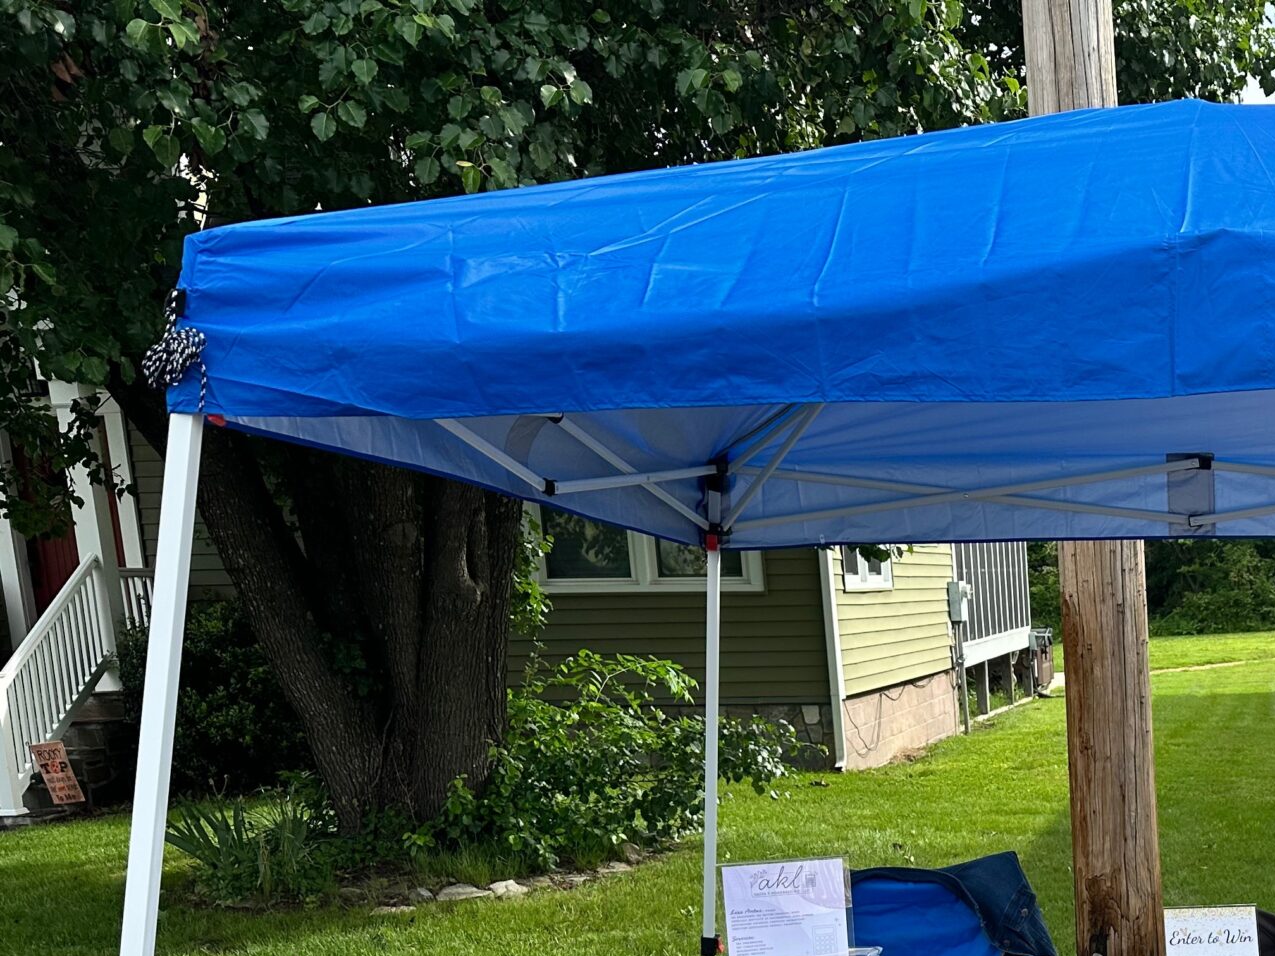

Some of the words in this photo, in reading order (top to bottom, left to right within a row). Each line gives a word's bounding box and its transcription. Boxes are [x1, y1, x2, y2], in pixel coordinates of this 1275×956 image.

[758, 865, 803, 892] akl
[1169, 930, 1204, 946] Enter
[1207, 932, 1220, 944] to
[1223, 928, 1254, 944] Win
